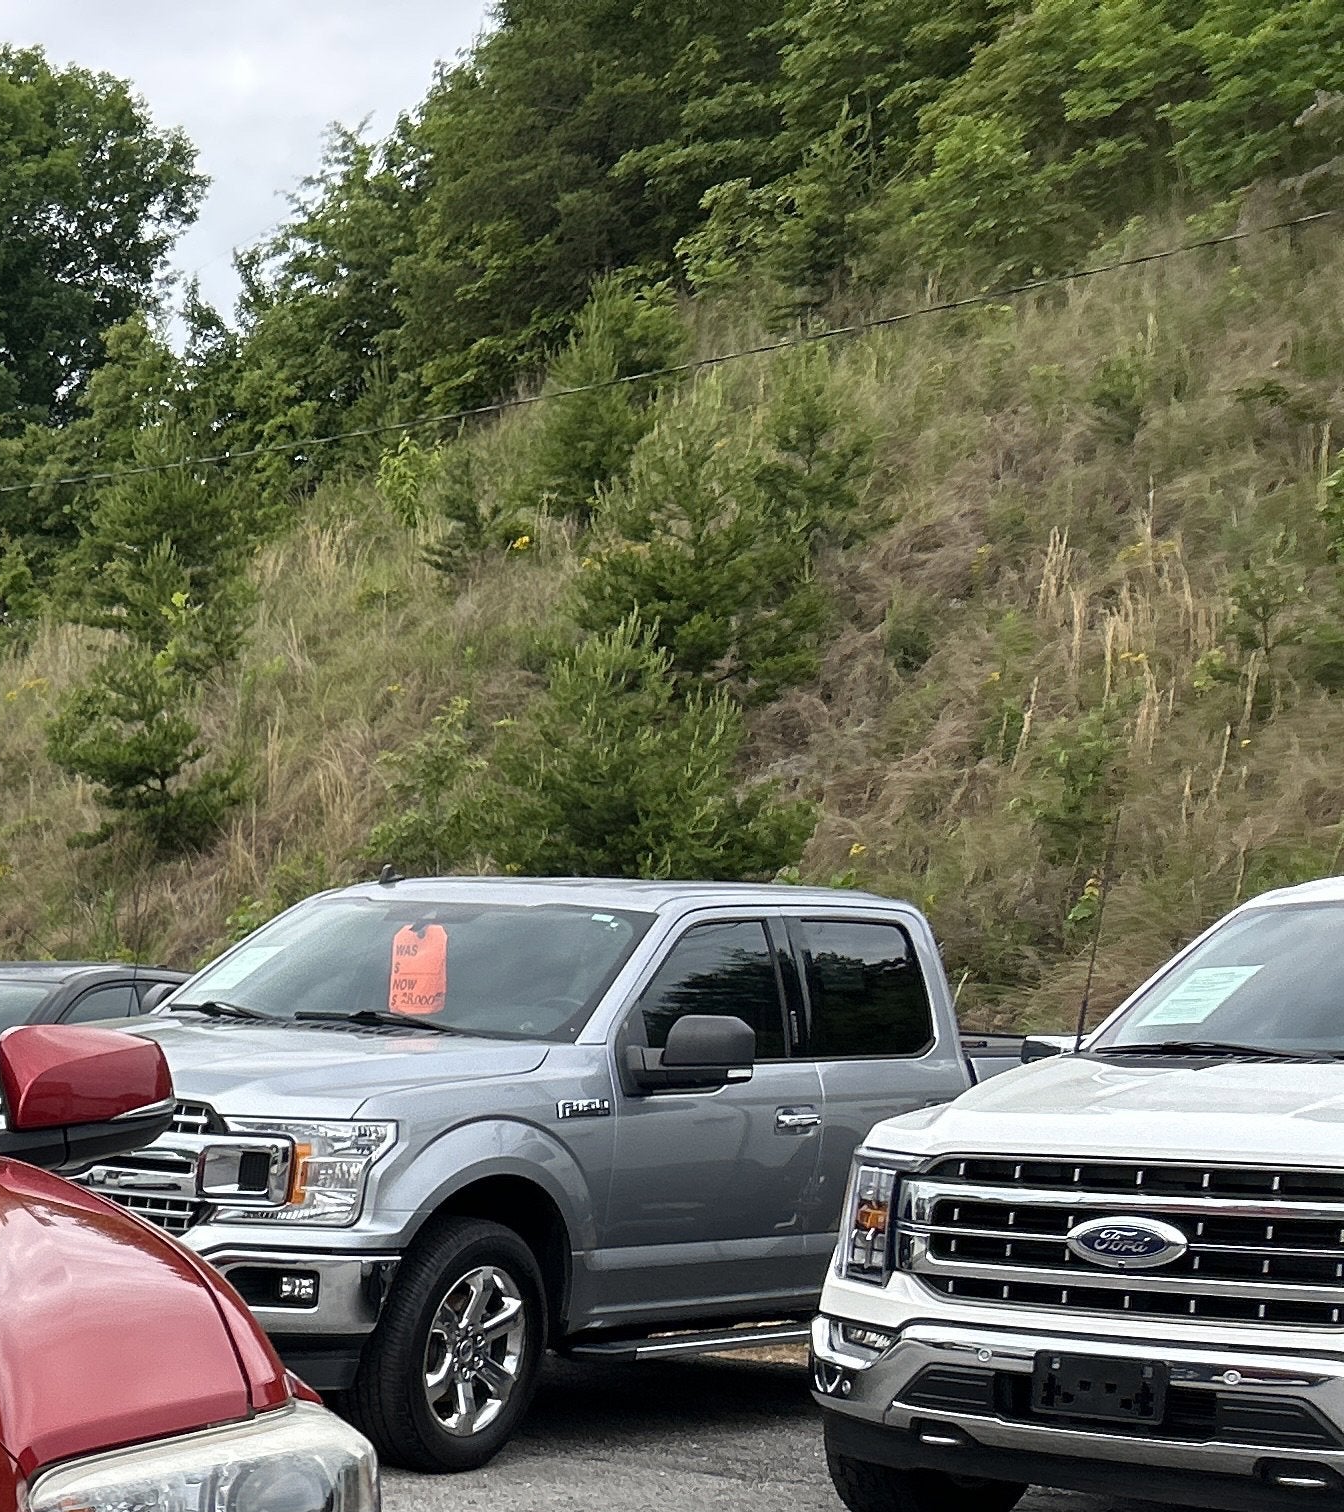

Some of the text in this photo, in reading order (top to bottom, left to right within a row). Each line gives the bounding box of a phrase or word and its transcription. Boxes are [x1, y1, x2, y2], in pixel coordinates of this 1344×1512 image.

[396, 945, 418, 957] WAS
[393, 979, 417, 990] NOW
[391, 994, 398, 1006] $
[1093, 1229, 1152, 1253] Ford
